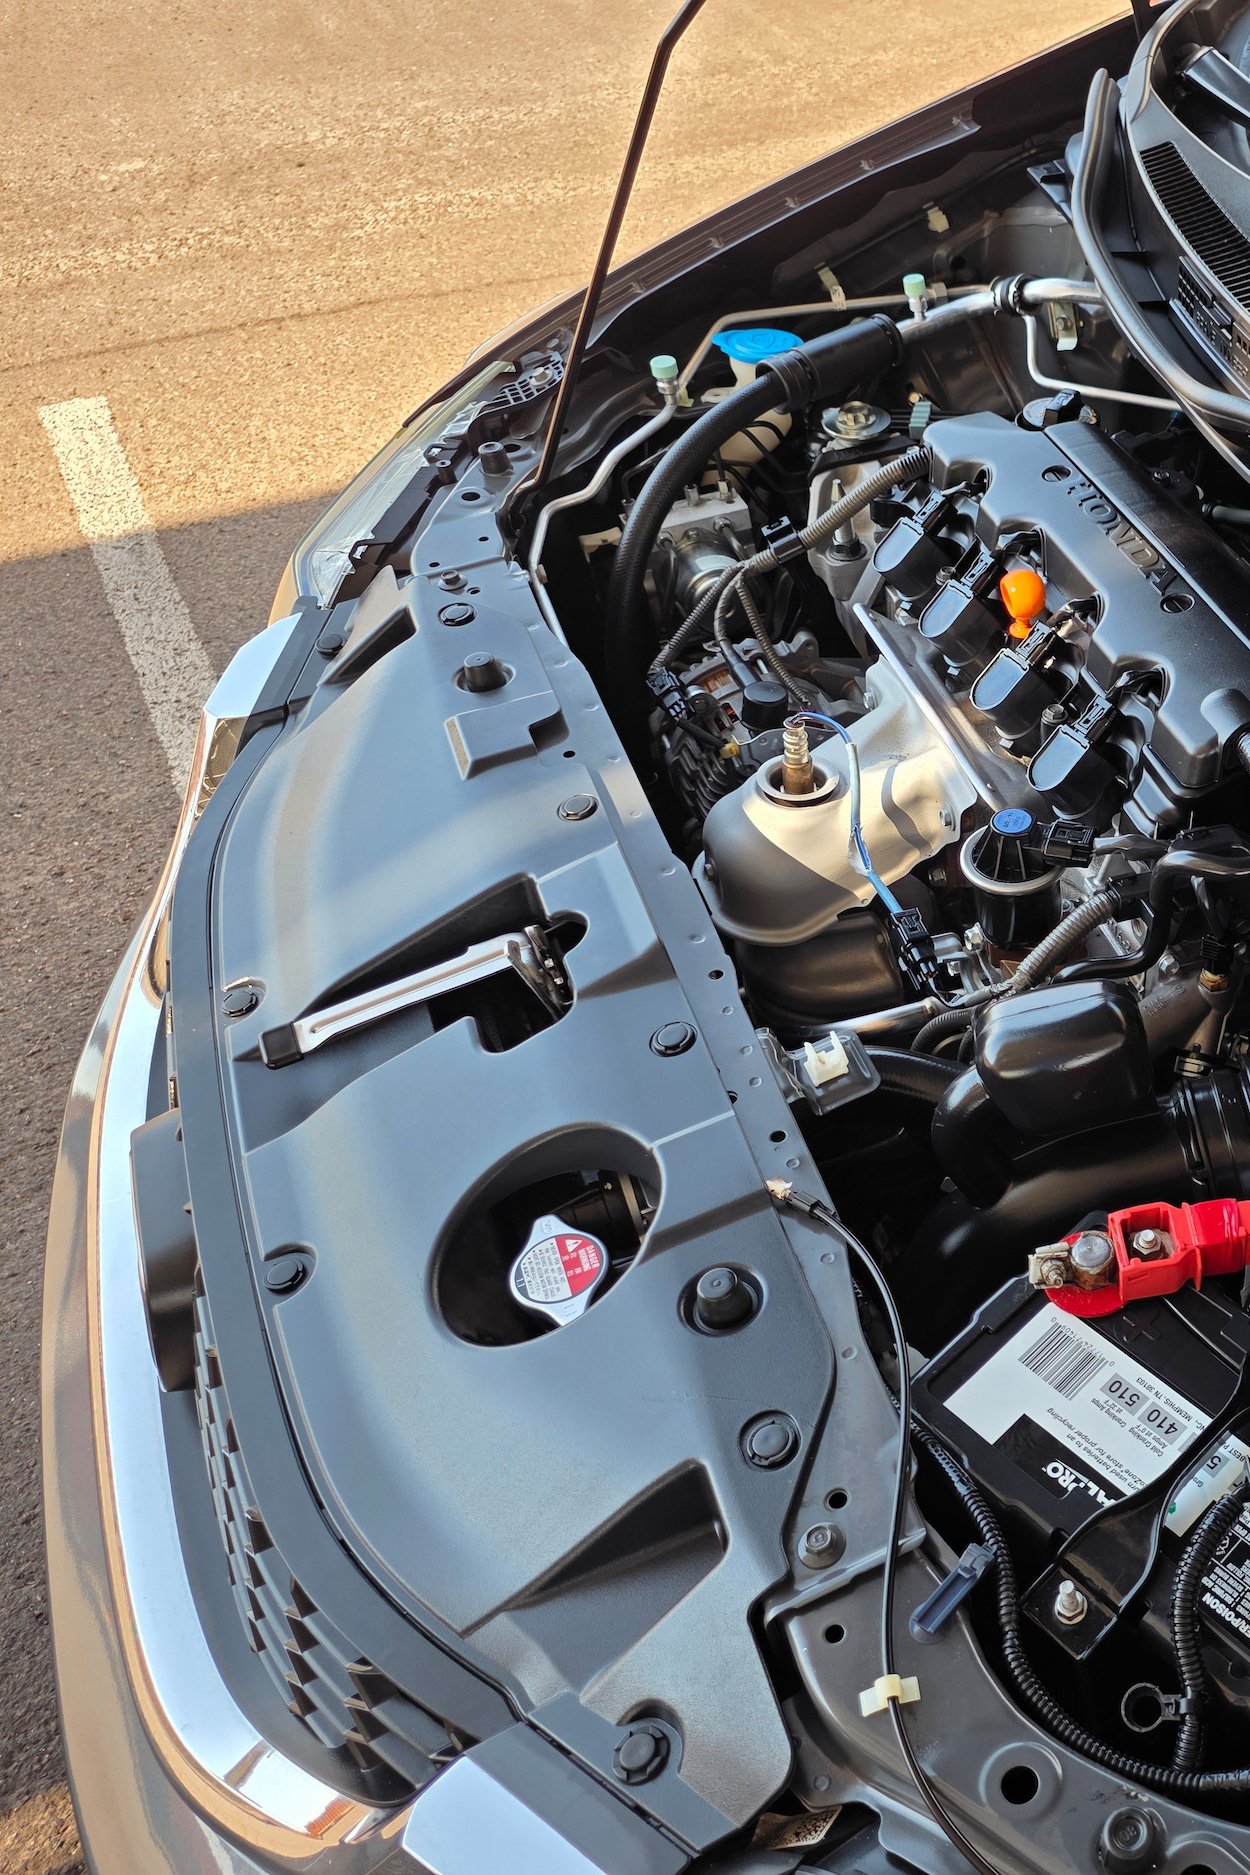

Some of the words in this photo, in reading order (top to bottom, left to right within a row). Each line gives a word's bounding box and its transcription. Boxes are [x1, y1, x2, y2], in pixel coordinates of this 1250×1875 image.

[1067, 478, 1178, 596] HONDA
[577, 1248, 591, 1272] WARNING
[585, 1244, 600, 1269] DANGER
[1083, 1340, 1104, 1358] 17724
[1107, 1377, 1141, 1409] 510
[1135, 1375, 1156, 1394] 38103
[1153, 1390, 1163, 1400] TN
[1089, 1396, 1106, 1412] Amps
[1115, 1406, 1123, 1414] at
[1161, 1395, 1193, 1423] MEMPHIS,
[1046, 1405, 1076, 1432] recycling
[1103, 1407, 1127, 1428] Cranking
[1145, 1406, 1180, 1438] 410
[1066, 1432, 1076, 1442] an
[1074, 1427, 1097, 1448] proper
[1127, 1425, 1152, 1448] Cranking
[1144, 1430, 1152, 1438] at
[1150, 1434, 1168, 1450] Amps
[1074, 1439, 1083, 1448] to
[1094, 1445, 1106, 1457] for
[1149, 1444, 1164, 1457] Cold
[1081, 1445, 1112, 1471] batteries
[1105, 1453, 1123, 1470] store
[1228, 1446, 1246, 1462] BEST
[1109, 1467, 1128, 1484] used
[1126, 1481, 1139, 1493] urn
[1208, 1572, 1218, 1581] OR
[1213, 1565, 1230, 1581] BURNS
[1225, 1561, 1245, 1578] FOLLOW
[1200, 1575, 1215, 1588] ACID
[1215, 1577, 1239, 1598] BLINDNESS
[1226, 1576, 1244, 1592] SEVERE
